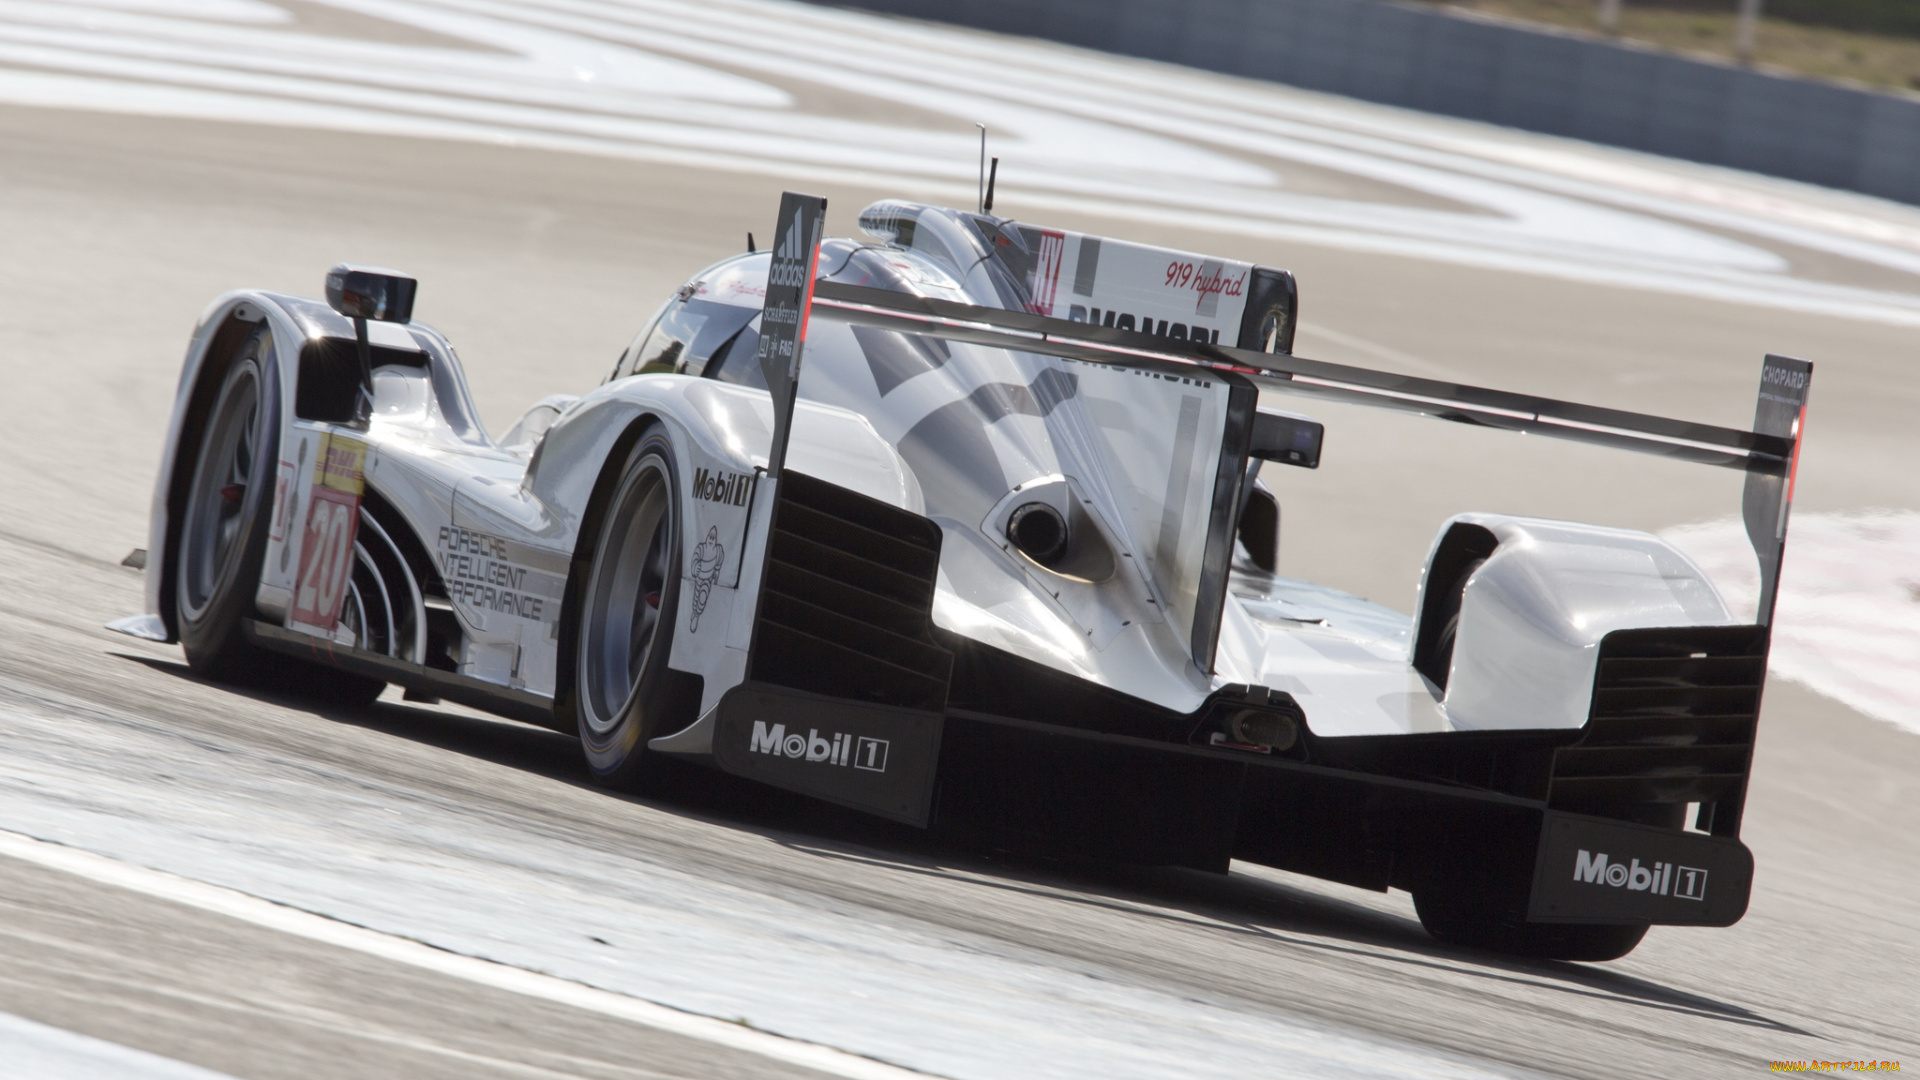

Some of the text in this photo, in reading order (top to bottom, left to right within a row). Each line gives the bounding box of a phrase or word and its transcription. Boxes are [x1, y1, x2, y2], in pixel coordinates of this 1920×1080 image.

[770, 257, 805, 287] adidas
[1165, 261, 1247, 310] 919 hybrid
[779, 340, 793, 356] FAG
[1762, 365, 1804, 389] CHOPARD
[692, 467, 737, 506] Mobil
[297, 499, 350, 618] 20
[438, 526, 508, 561] PORSCHE
[750, 720, 852, 767] Mobil
[1573, 849, 1672, 896] Mobil
